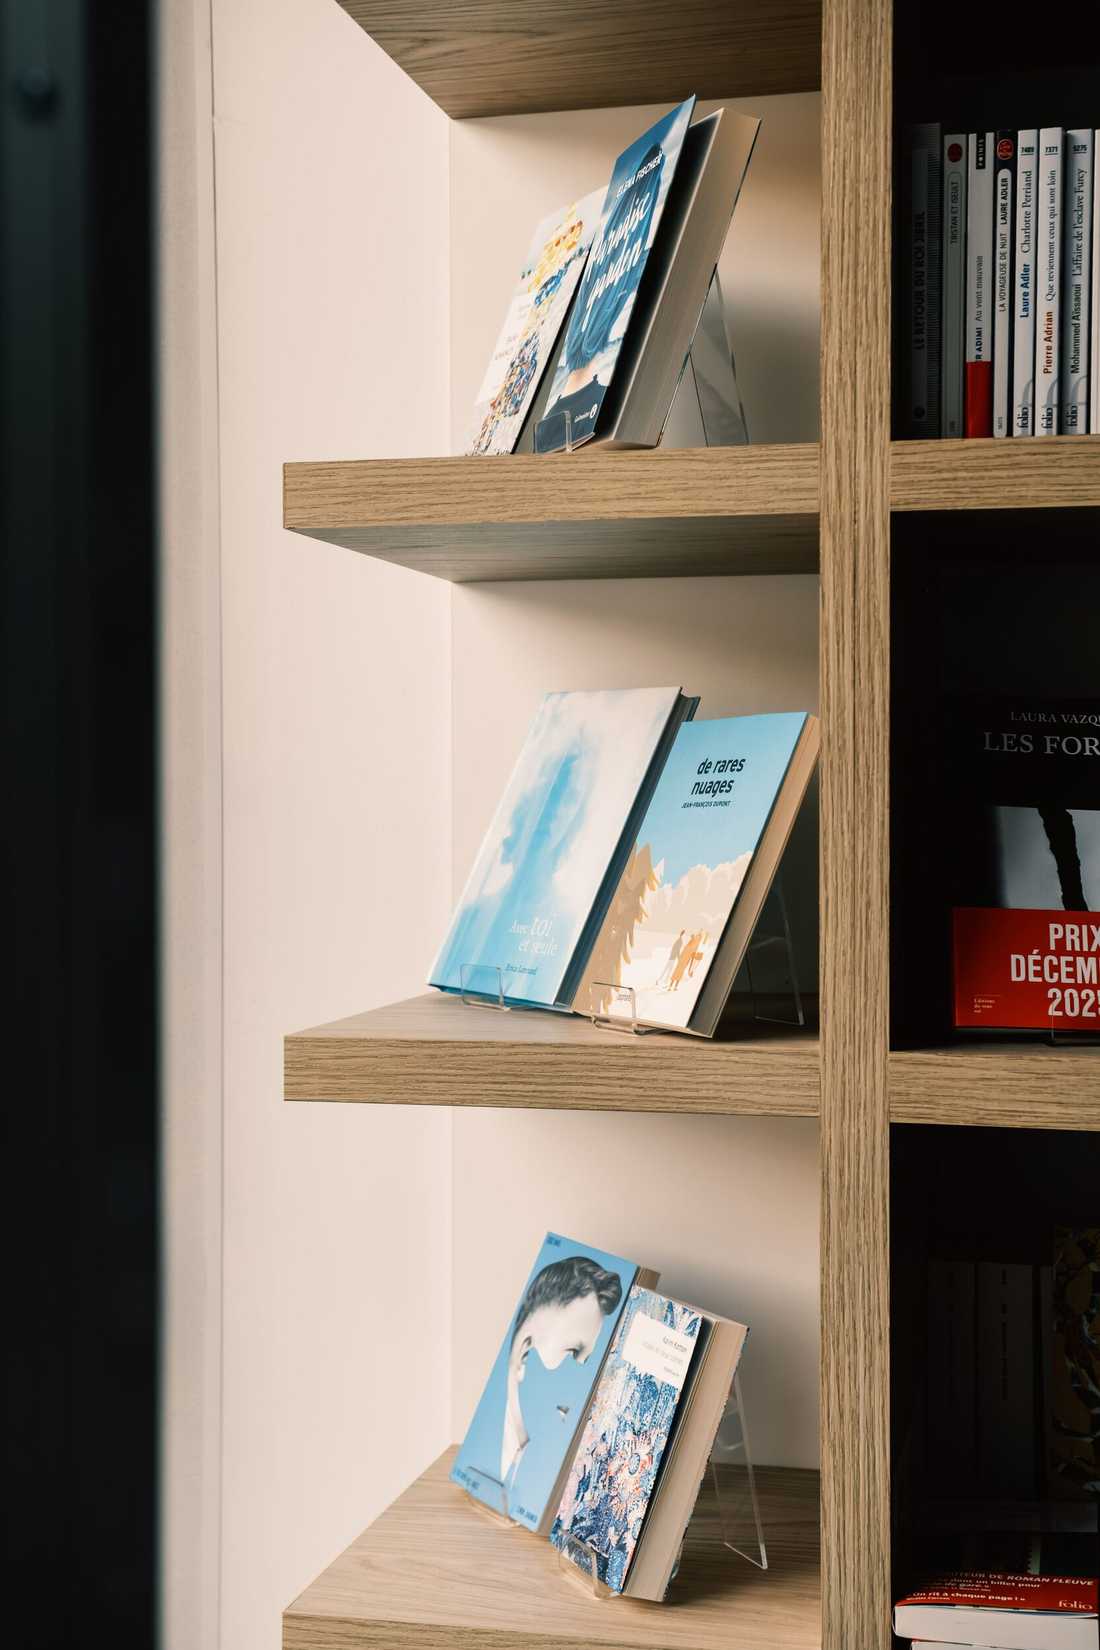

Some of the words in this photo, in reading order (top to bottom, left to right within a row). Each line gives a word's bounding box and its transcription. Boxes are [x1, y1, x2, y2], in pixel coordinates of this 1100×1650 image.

[635, 152, 662, 182] FISCHER
[1047, 170, 1056, 186] loin
[1000, 177, 1009, 200] ADLER
[1022, 170, 1032, 208] Perriand
[1074, 168, 1087, 193] Furcy
[1000, 202, 1008, 225] LAURE
[1048, 206, 1057, 219] qui
[1000, 232, 1008, 248] NUIT
[1021, 210, 1032, 254] Charlotte
[1073, 231, 1083, 242] de
[1047, 241, 1055, 282] reviennent
[581, 234, 648, 332] garden
[999, 264, 1007, 301] VOYAGEUSE
[1020, 263, 1030, 290] Adler
[1020, 291, 1030, 318] Laure
[1046, 284, 1056, 302] Que
[1071, 283, 1082, 321] Aïssaoui
[1043, 311, 1053, 343] Adrian
[1043, 344, 1053, 374] Pierre
[1070, 322, 1081, 374] Mohammed
[1017, 406, 1029, 429] folio
[1041, 407, 1053, 429] folio
[1066, 405, 1078, 426] folio
[1011, 711, 1057, 723] LAURA
[984, 732, 1034, 753] LES
[697, 758, 713, 775] de
[713, 758, 746, 774] rares
[691, 780, 735, 798] nuages
[1010, 949, 1100, 985] DÉCEM
[1007, 1575, 1050, 1583] ROMAN
[1052, 1578, 1094, 1586] FLEUVE
[1058, 1600, 1093, 1609] folio
